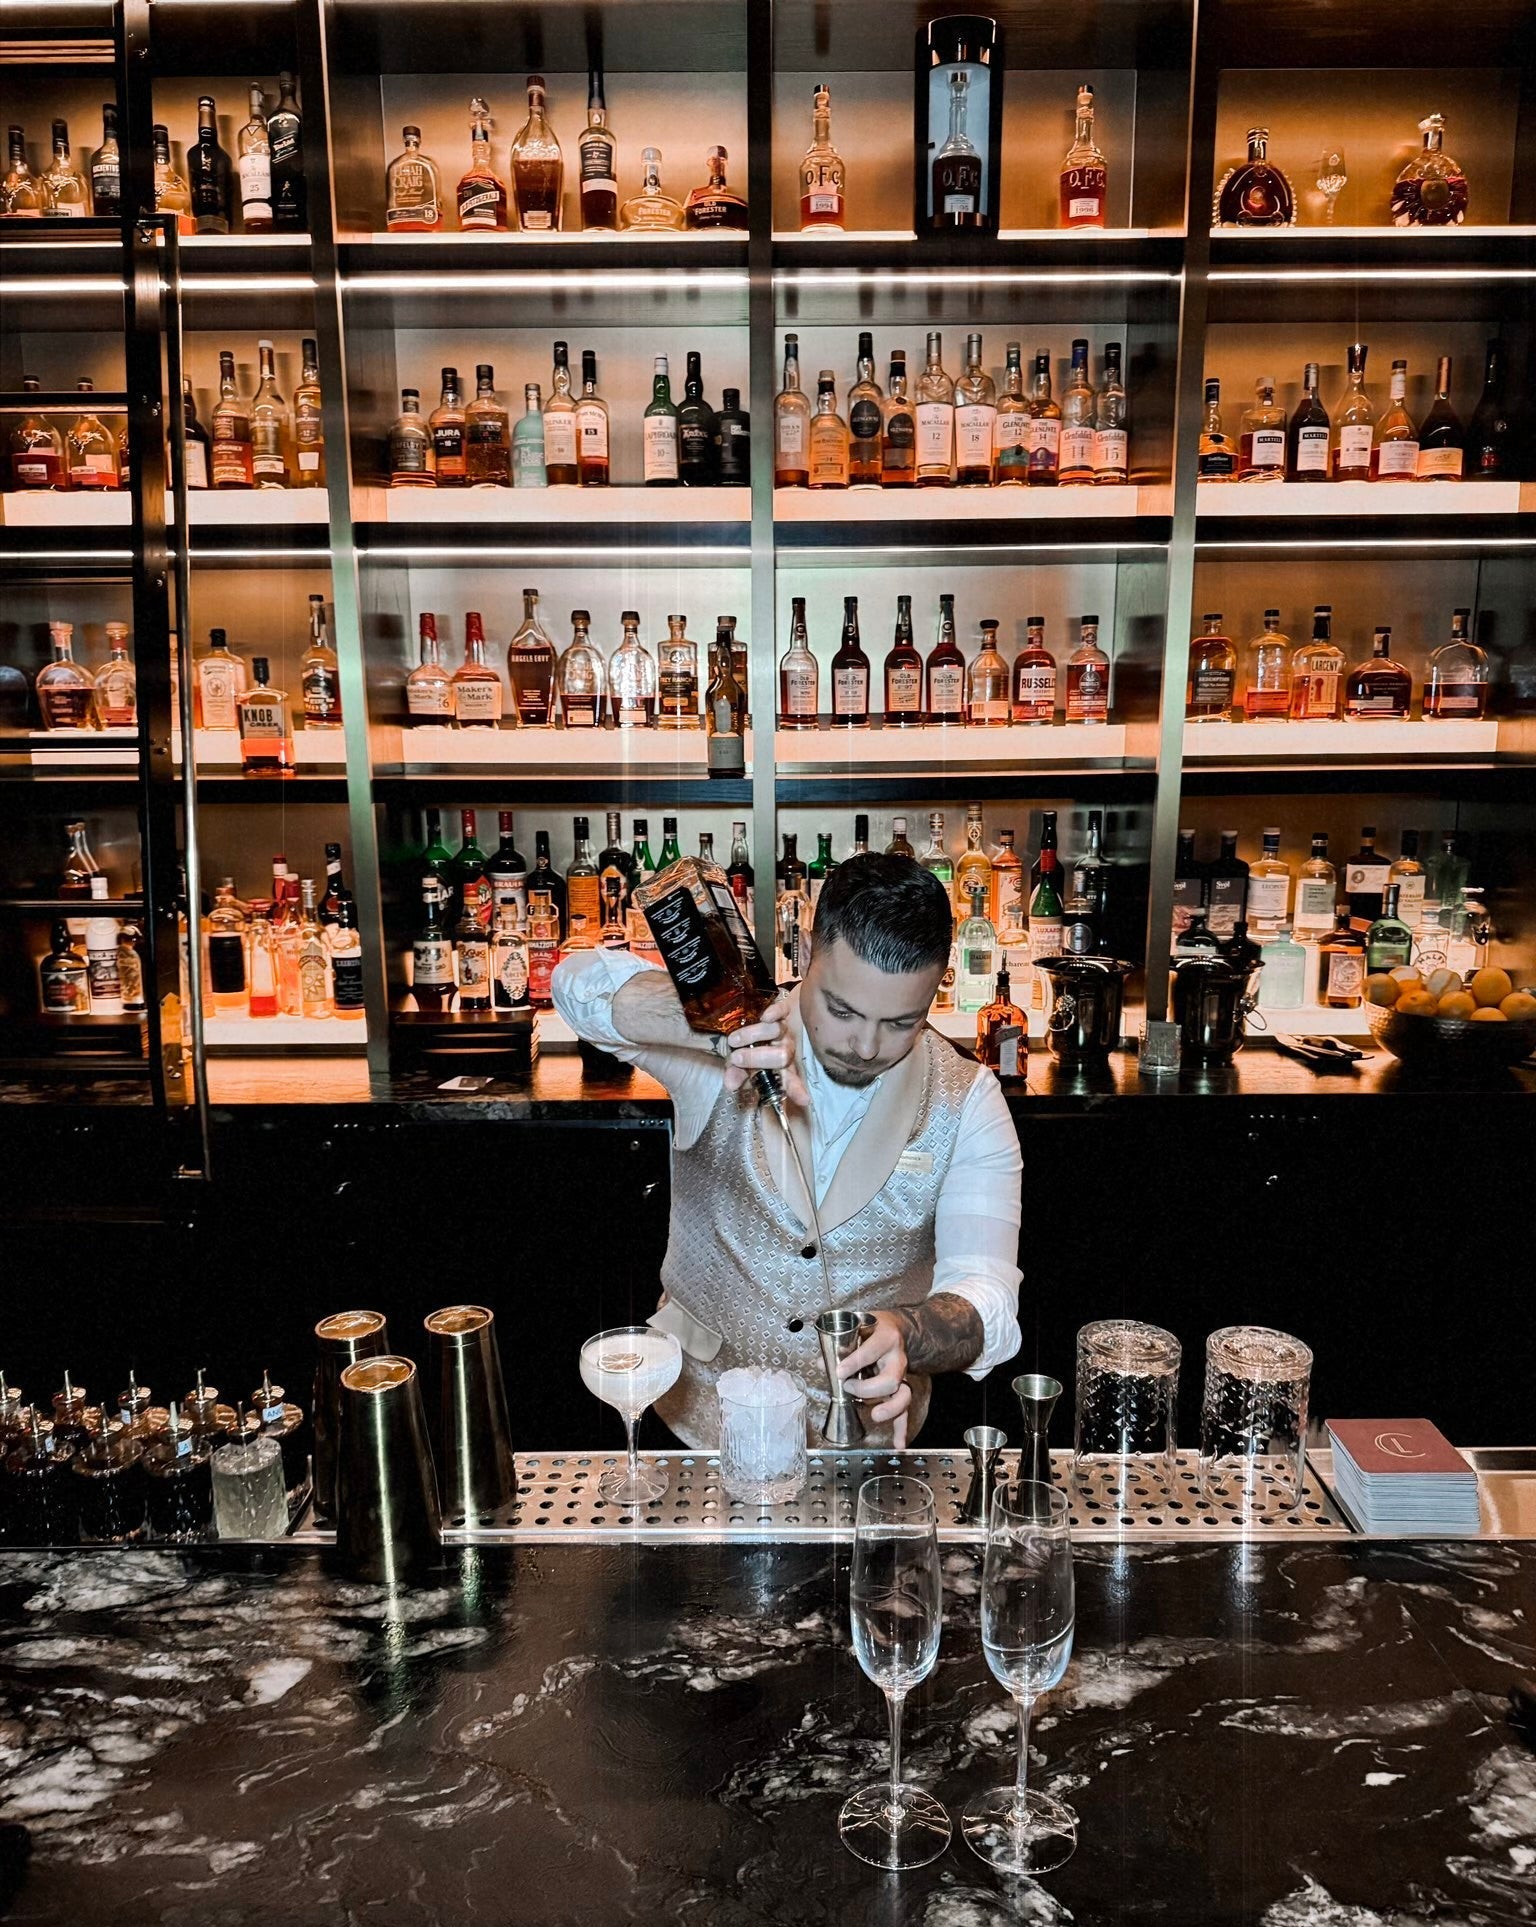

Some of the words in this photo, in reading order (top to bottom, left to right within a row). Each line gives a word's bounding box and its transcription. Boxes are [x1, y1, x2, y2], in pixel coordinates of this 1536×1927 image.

[395, 176, 423, 188] CRAIG
[250, 185, 260, 193] 25
[424, 210, 434, 218] 18
[695, 206, 728, 215] FORESTER
[435, 429, 461, 437] JURA
[657, 449, 665, 457] 10
[1105, 447, 1119, 461] 15
[1312, 661, 1339, 672] LARCENY
[243, 708, 273, 722] KNOB
[1037, 707, 1046, 716] 10
[1417, 954, 1446, 964] MALFY
